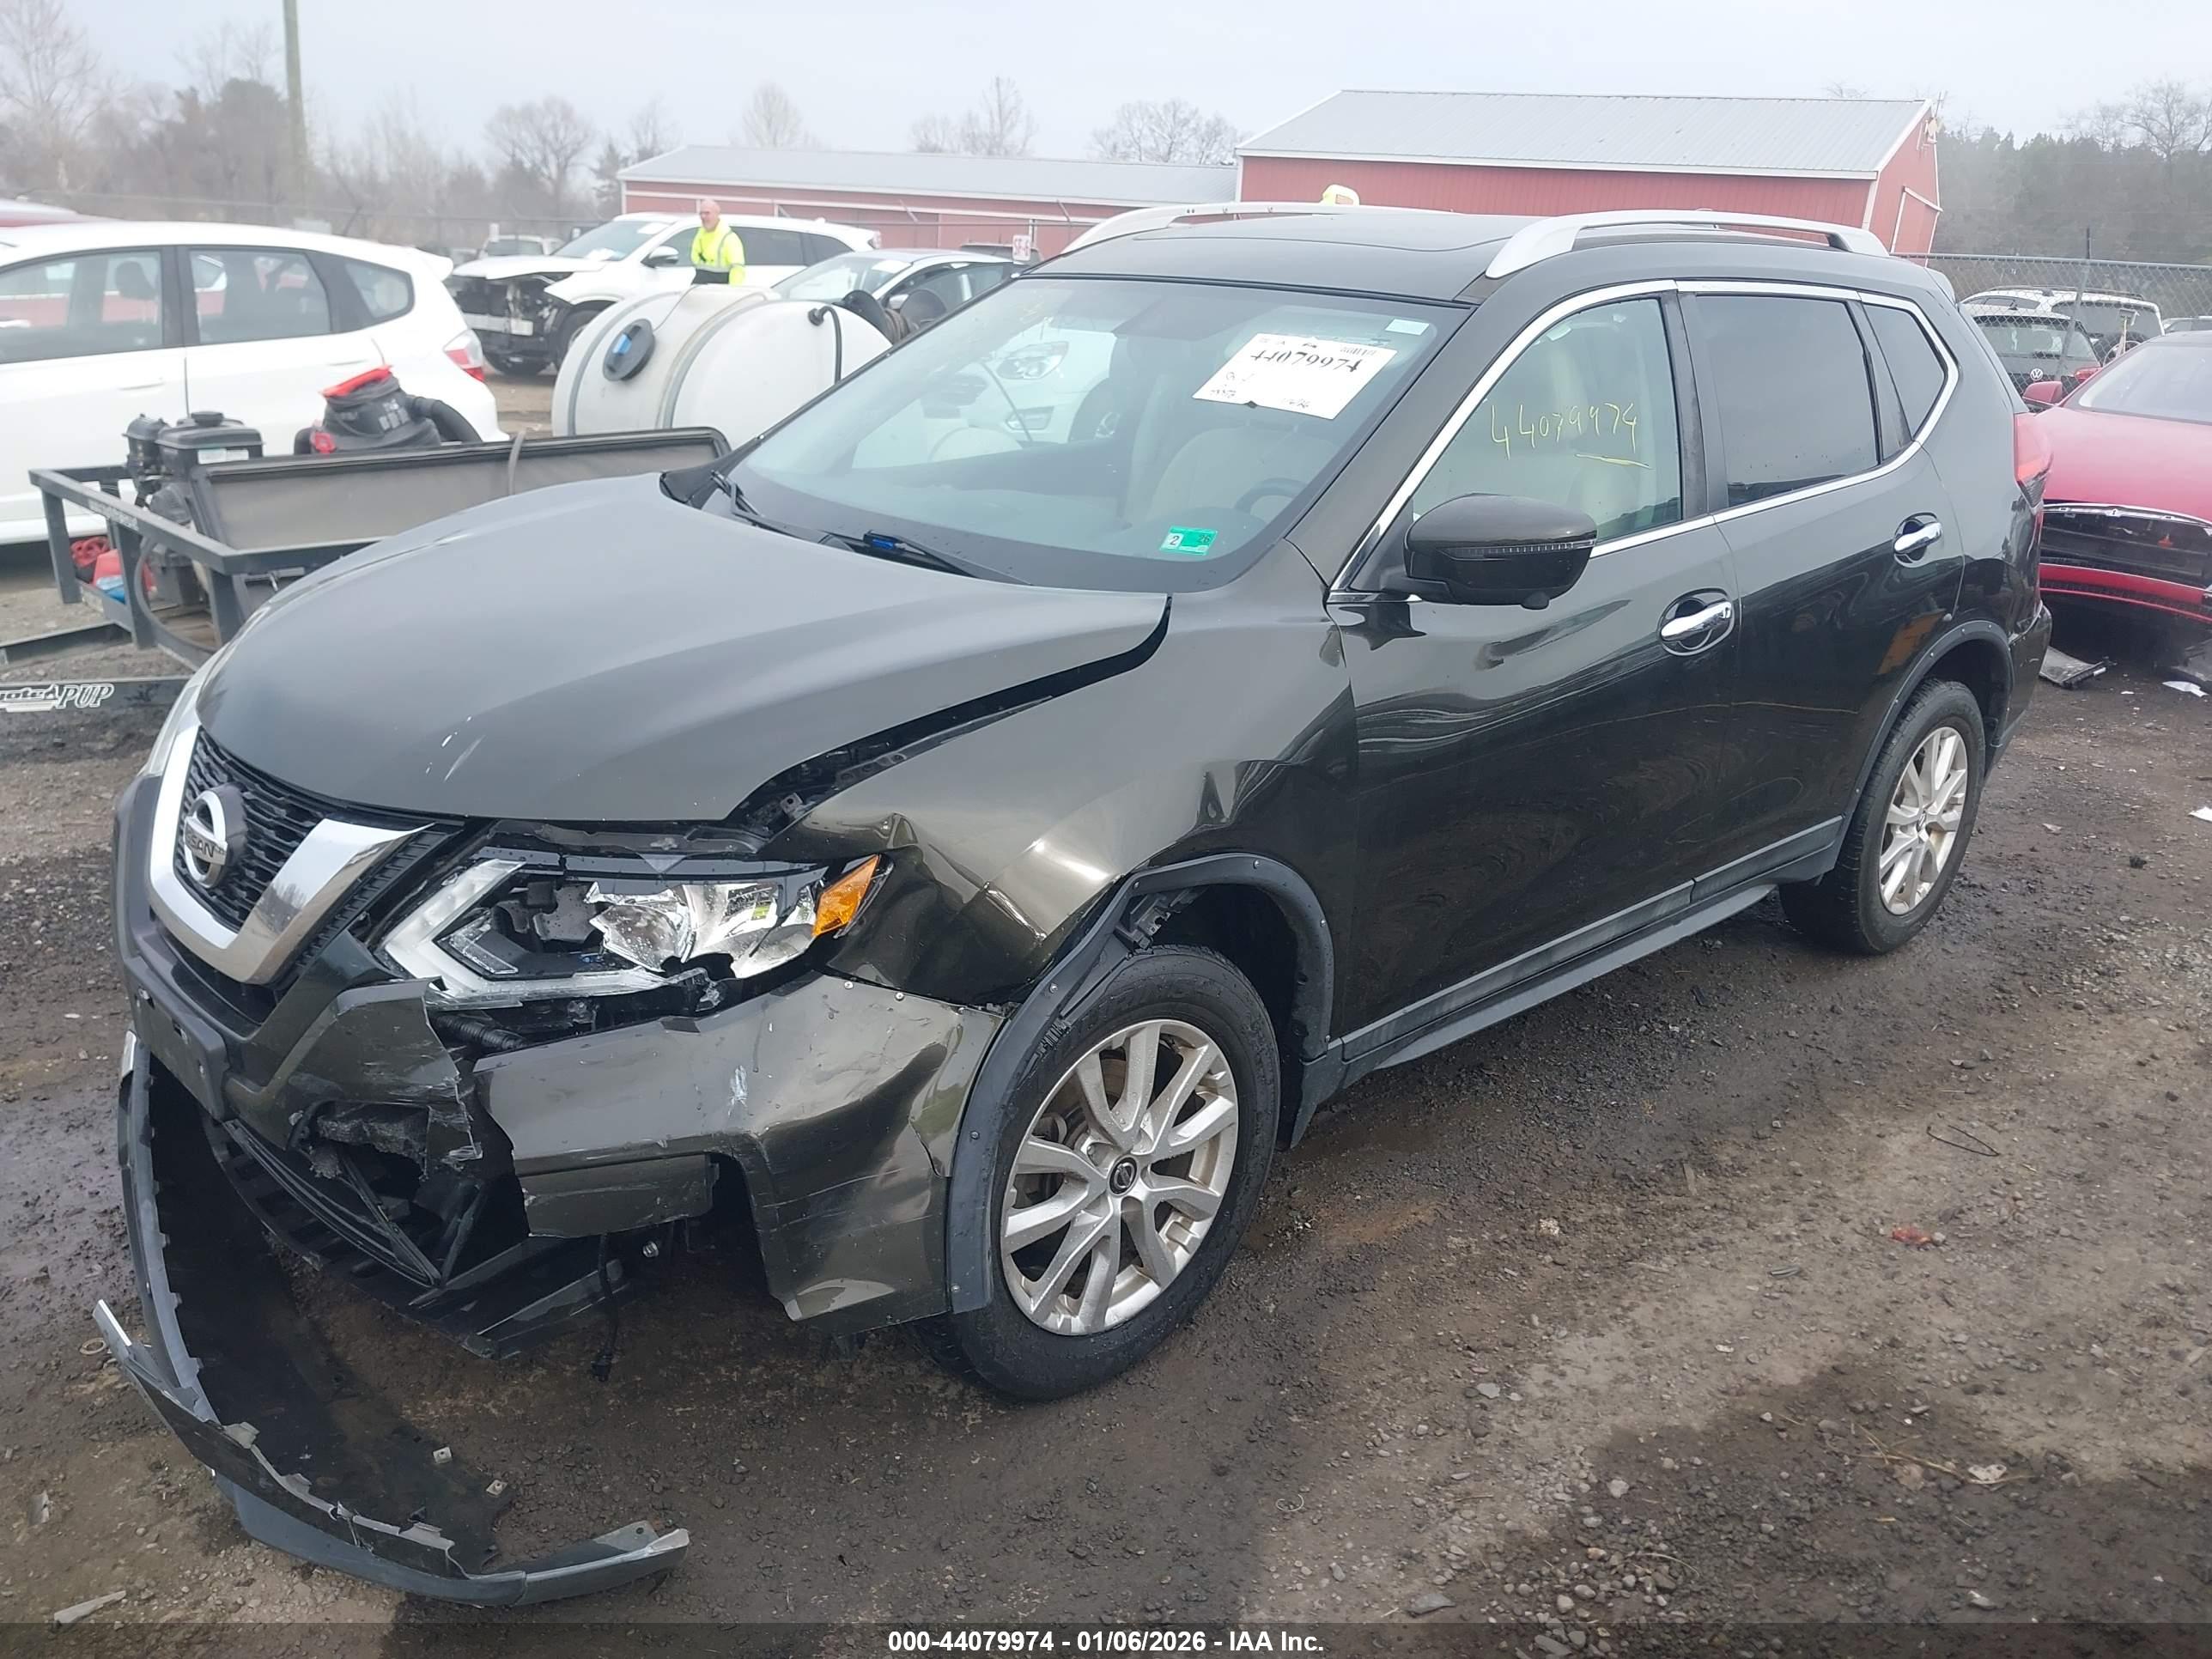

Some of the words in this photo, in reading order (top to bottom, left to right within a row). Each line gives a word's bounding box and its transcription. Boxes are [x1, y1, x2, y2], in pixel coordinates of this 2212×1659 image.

[1491, 402, 1638, 460] 44079974
[1170, 535, 1180, 546] 2
[54, 684, 115, 709] PUP
